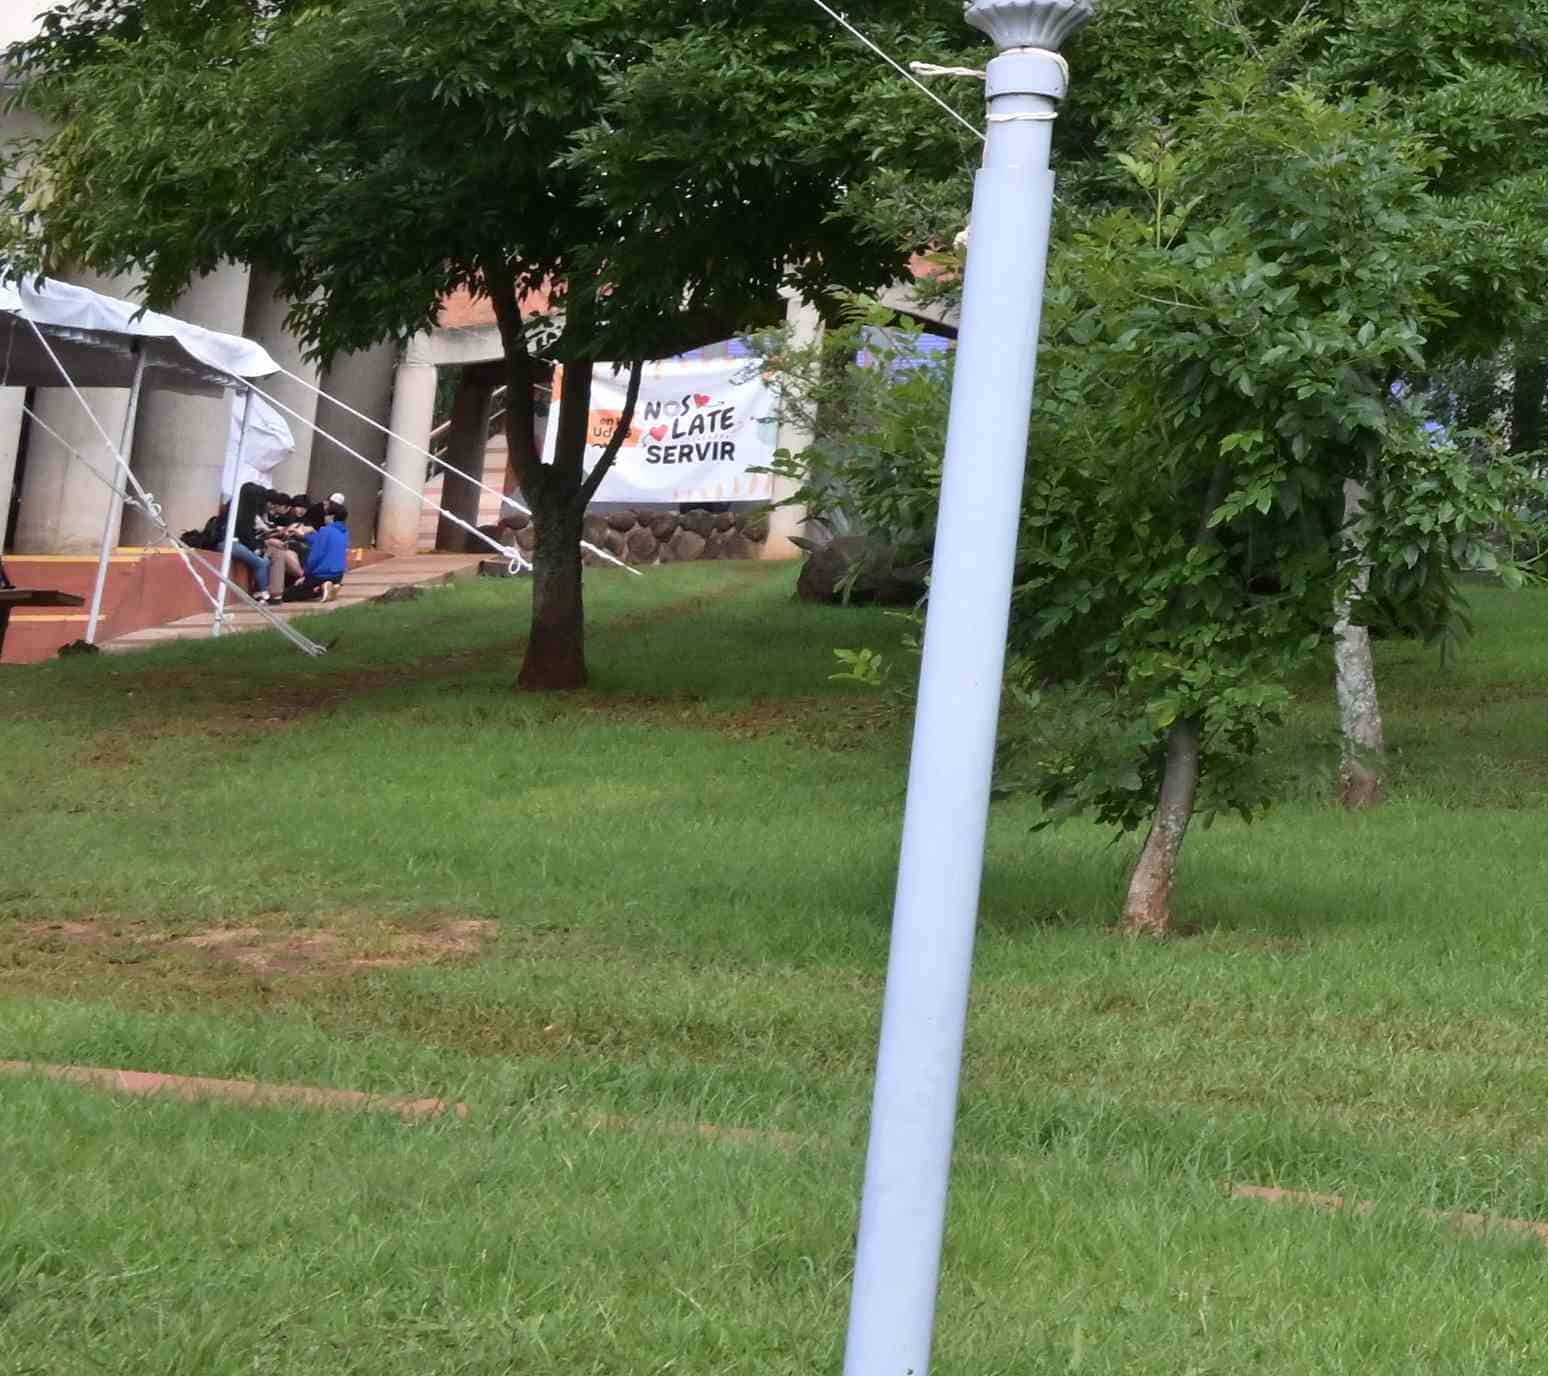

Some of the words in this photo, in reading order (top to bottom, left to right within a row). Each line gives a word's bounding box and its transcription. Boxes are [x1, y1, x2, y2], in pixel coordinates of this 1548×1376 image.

[644, 395, 692, 421] NOS
[671, 406, 736, 440] LATE
[646, 441, 736, 464] SERVIR
